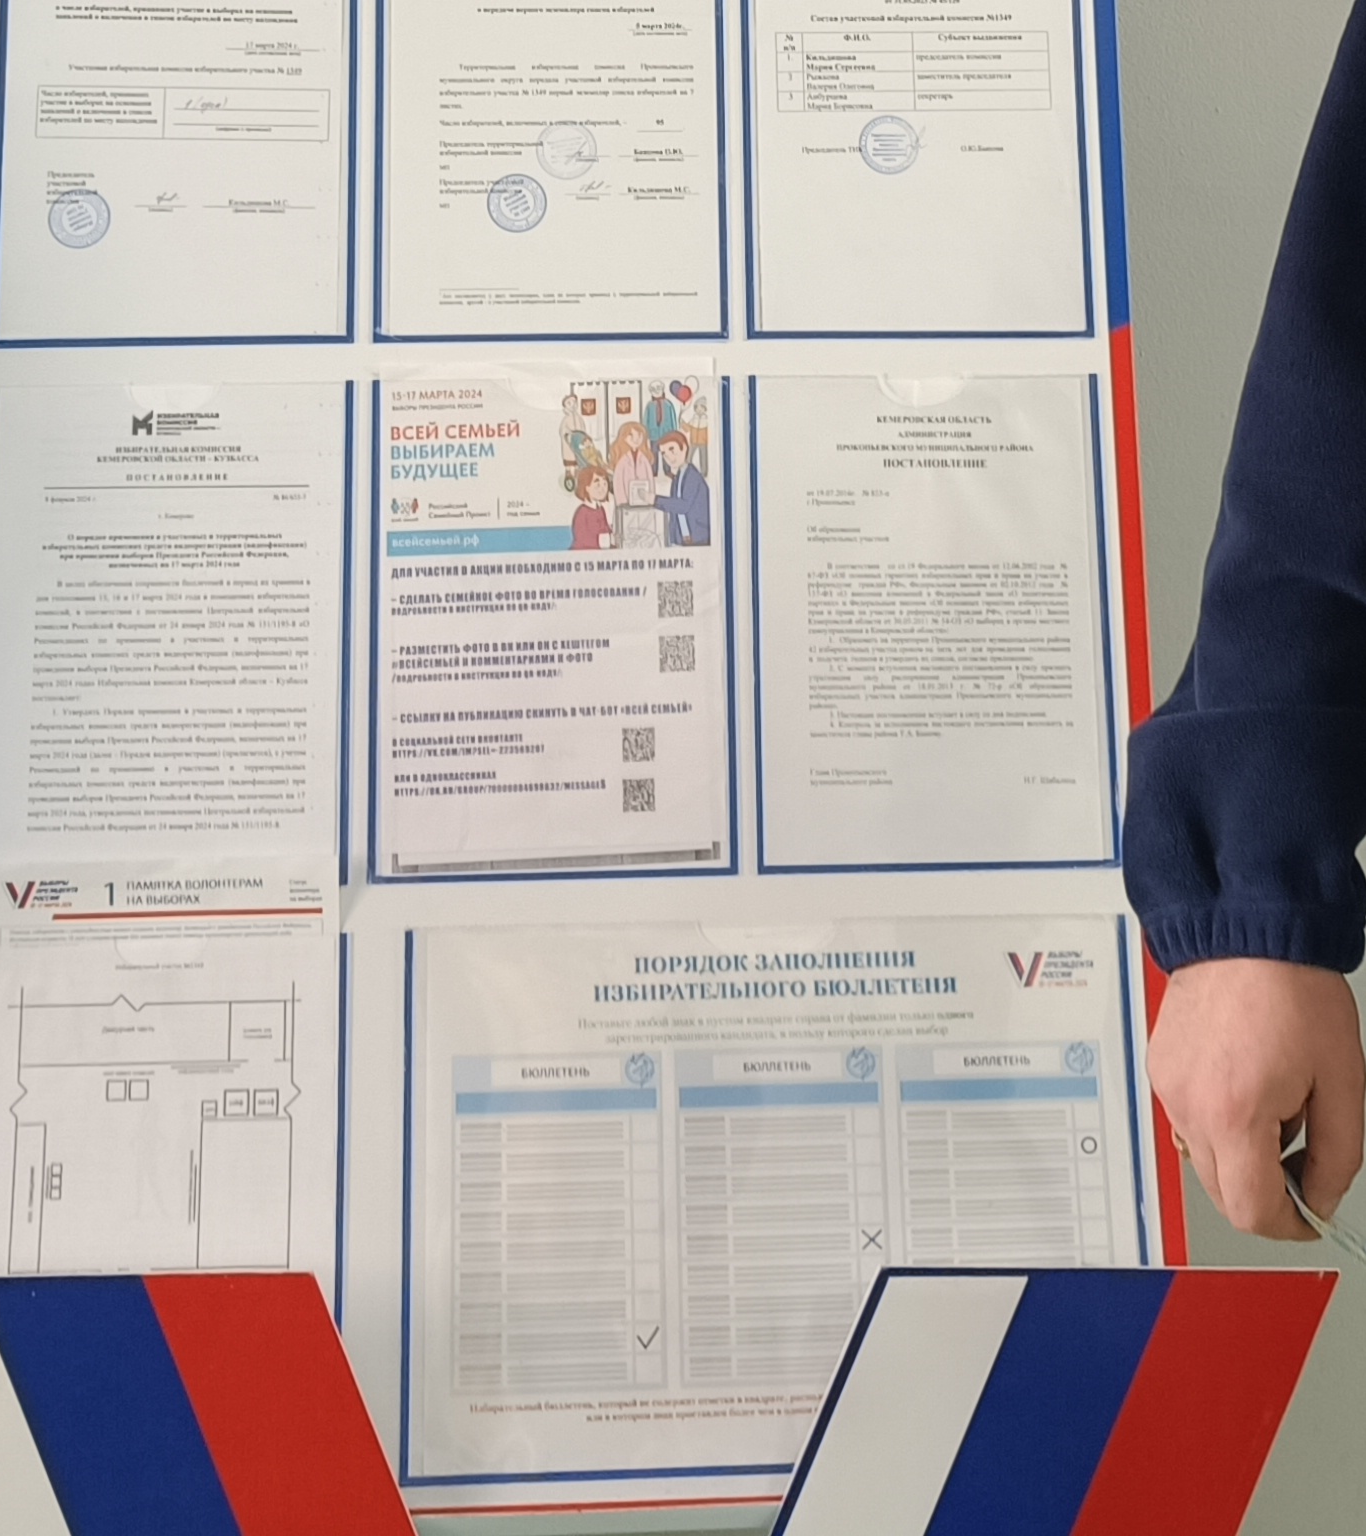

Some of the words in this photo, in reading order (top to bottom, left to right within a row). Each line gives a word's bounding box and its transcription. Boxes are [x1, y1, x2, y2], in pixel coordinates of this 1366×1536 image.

[391, 390, 417, 401] 15-17
[418, 389, 456, 400] МАРТА
[458, 389, 483, 400] 2024
[876, 415, 947, 424] КЕМЕРОВСКАЯ
[947, 415, 993, 424] ОБЛАСТЬ
[390, 421, 439, 441] ВСЕЙ
[444, 422, 521, 440] СЕМЬЕЙ
[898, 431, 973, 439] АДМИНИСТРАЦИЯ
[114, 446, 190, 454] ИЗБИРАТЕЛЬНАЯ
[190, 445, 242, 453] КОМИССИЯ
[390, 442, 495, 460] ВЫБИРАЕМ
[915, 444, 998, 452] МУНИЦИПАЛЬНОГО
[998, 443, 1034, 452] РАЙОНА
[95, 455, 164, 463] КЕМЕРОВСКОЙ
[164, 455, 207, 463] ОБЛАСТИ
[882, 458, 988, 468] ПОСТАНОВЛЕНИЕ
[390, 462, 479, 481] БУДУЩЕЕ
[390, 567, 413, 580] ДЛЯ
[414, 565, 459, 578] УЧАСТИЯ
[469, 563, 504, 576] АКЦИИ
[504, 561, 573, 575] НЕОБХОДИМО
[583, 561, 595, 572] 15
[596, 560, 630, 572] МАРТА
[658, 558, 694, 569] МАРТА:
[399, 593, 443, 606] СДЕЛАТЬ
[444, 591, 493, 603] СЕМЕЙНОЕ
[494, 590, 523, 602] ФОТО
[539, 588, 571, 600] ВРЕМЯ
[572, 586, 641, 599] ГОЛОСОВАНИЯ
[399, 643, 461, 656] РАЗМЕСТИТЬ
[462, 642, 490, 654] ФОТО
[125, 880, 183, 891] ПАМЯТКА
[184, 878, 264, 890] ВОЛОНТЕРАМ
[103, 882, 116, 907] 1
[126, 895, 143, 906] НА
[145, 894, 201, 906] ВЫБОРАХ
[634, 954, 748, 975] ПОРЯДОК
[755, 950, 916, 971] ЗАПОЛНЕНИЯ
[593, 980, 806, 1002] ИЗБИРАТЕЛЬНОГО
[813, 976, 958, 997] БЮЛЛЕТЕНЯ
[742, 1060, 812, 1073] БЮЛЛЕТЕНЬ
[963, 1055, 1031, 1068] БЮЛЛЕТЕНЬ
[520, 1066, 591, 1079] БЮЛЛЕТЕНЬ
